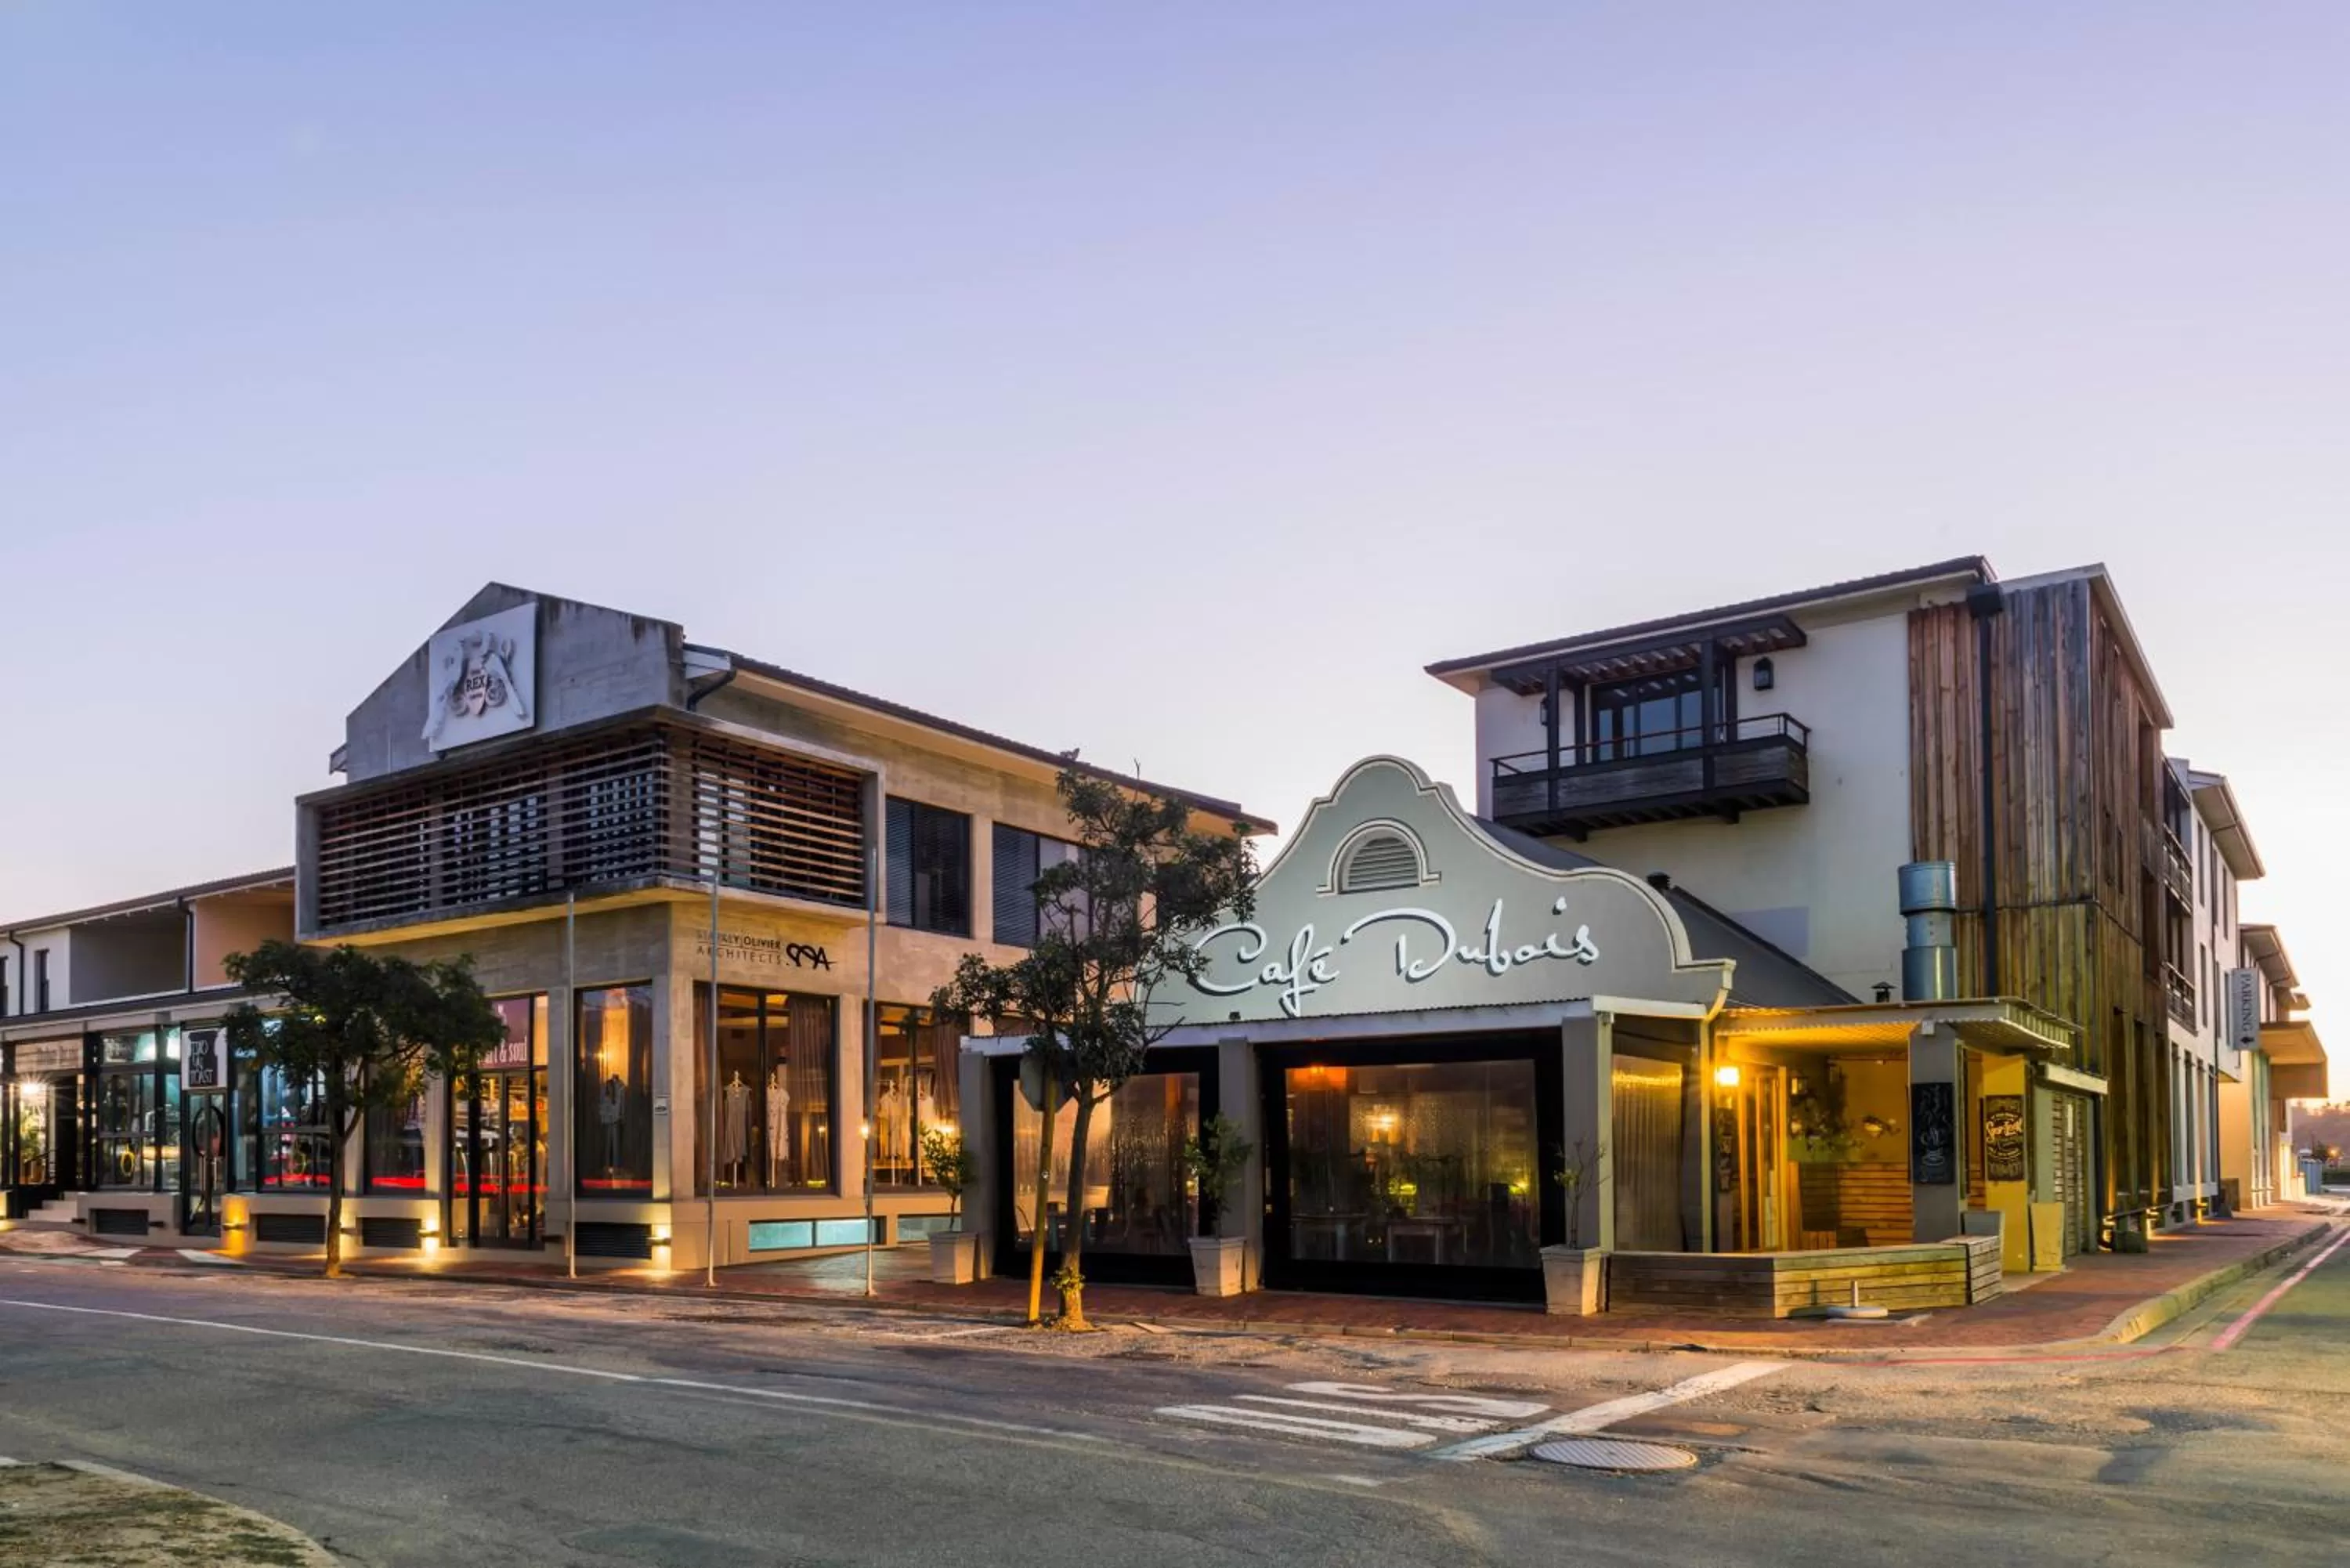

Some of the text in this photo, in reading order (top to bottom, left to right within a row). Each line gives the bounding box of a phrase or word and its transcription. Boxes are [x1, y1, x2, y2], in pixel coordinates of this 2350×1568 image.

[466, 675, 485, 692] REX
[743, 935, 781, 950] OLIVIER
[1195, 898, 1600, 1017] Café Dubois
[2240, 973, 2253, 1031] PARKING
[508, 1035, 527, 1063] soul
